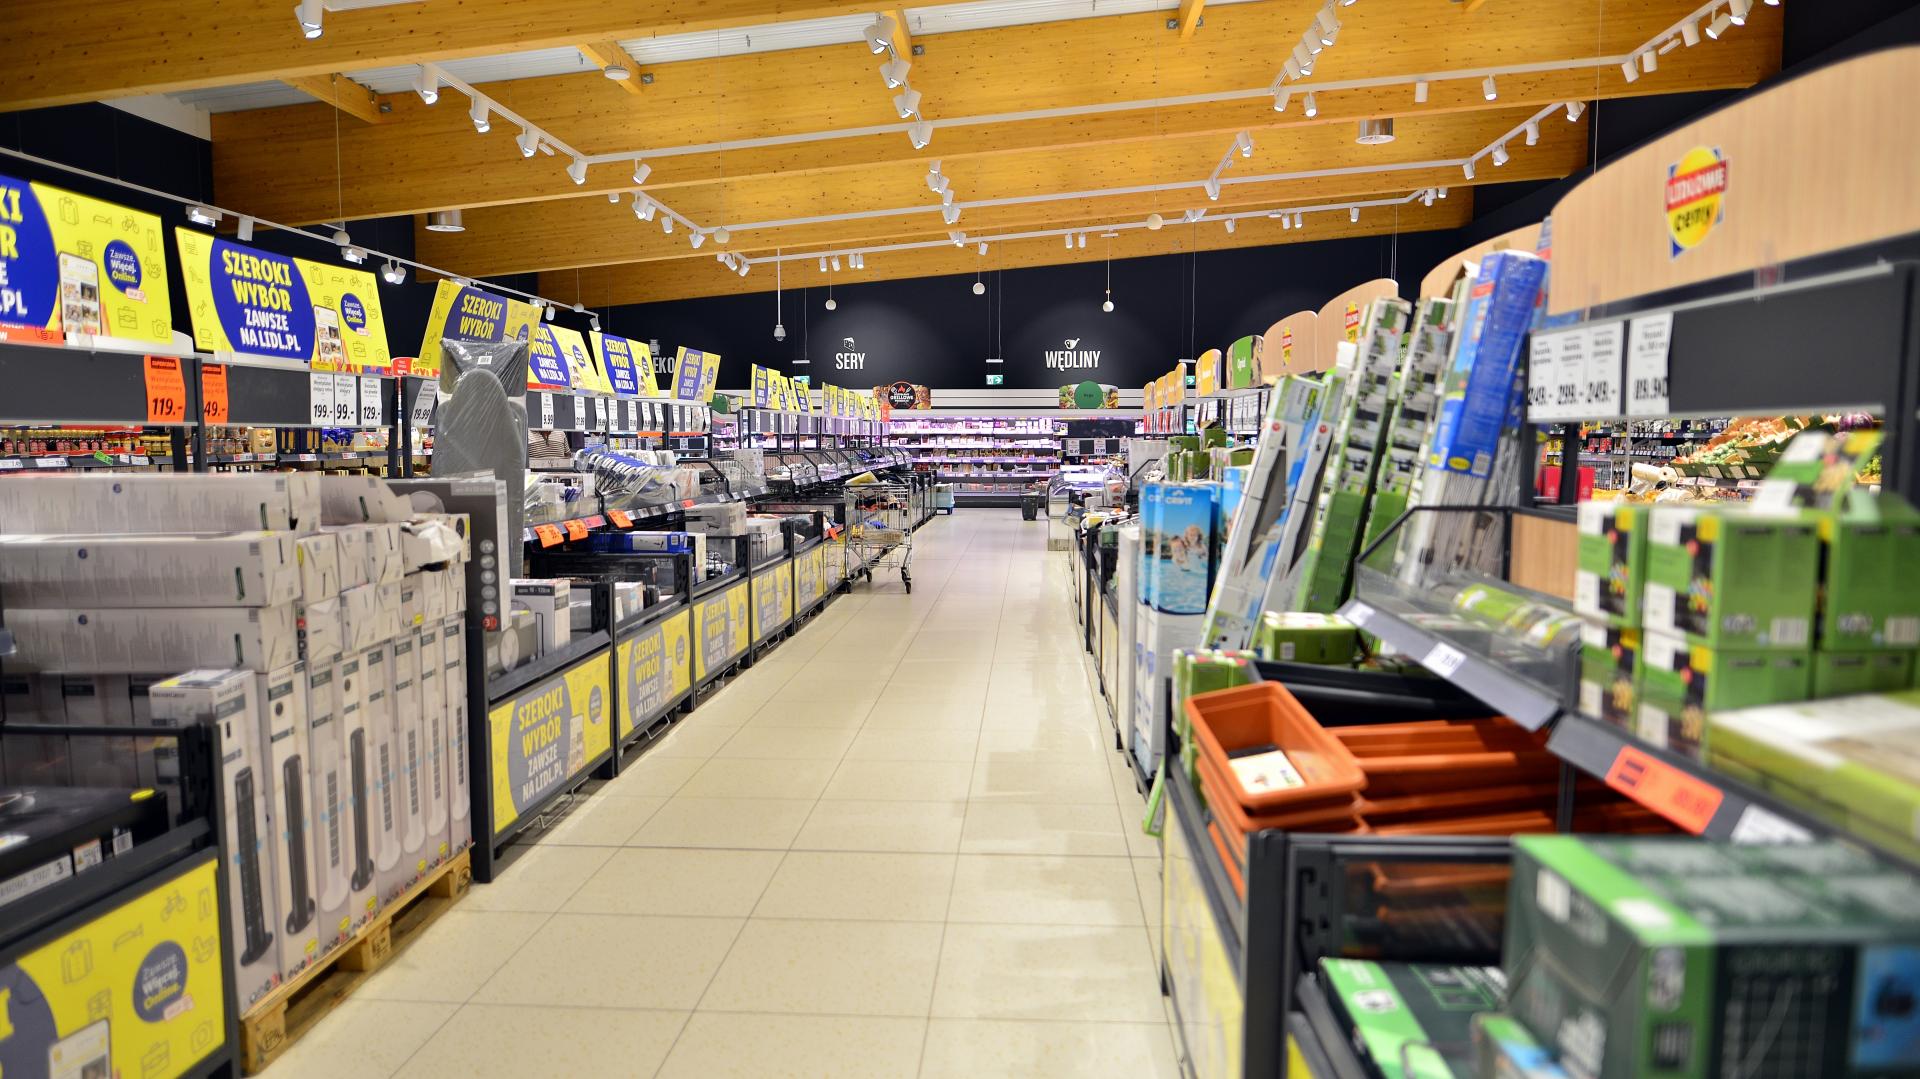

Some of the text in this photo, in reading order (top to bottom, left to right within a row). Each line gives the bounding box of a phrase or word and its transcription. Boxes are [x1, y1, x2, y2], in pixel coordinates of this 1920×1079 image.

[222, 249, 292, 287] SZEROKI
[232, 279, 292, 312] WYBÓR
[462, 294, 503, 321] SZEROKI
[244, 309, 289, 332] ZAWSZE
[460, 314, 495, 340] WYBÓR
[240, 327, 301, 352] NA LIDL.PL
[604, 338, 629, 355] SZEROKI
[652, 356, 675, 374] EKO
[835, 352, 866, 370] SERY
[1045, 350, 1101, 372] WĘDLINY
[152, 397, 183, 417] 119.-
[314, 404, 333, 418] 199.-
[336, 403, 355, 420] 99.-
[363, 406, 381, 420] 129.-
[413, 408, 431, 420] 19.99
[634, 630, 661, 665] SZEROKI
[635, 654, 660, 686] WYBÓR
[518, 685, 563, 732] SZEROKI
[522, 714, 562, 759] WYBÓR
[528, 743, 558, 778] ZAWSZE
[522, 759, 563, 803] NA LIDL.PL
